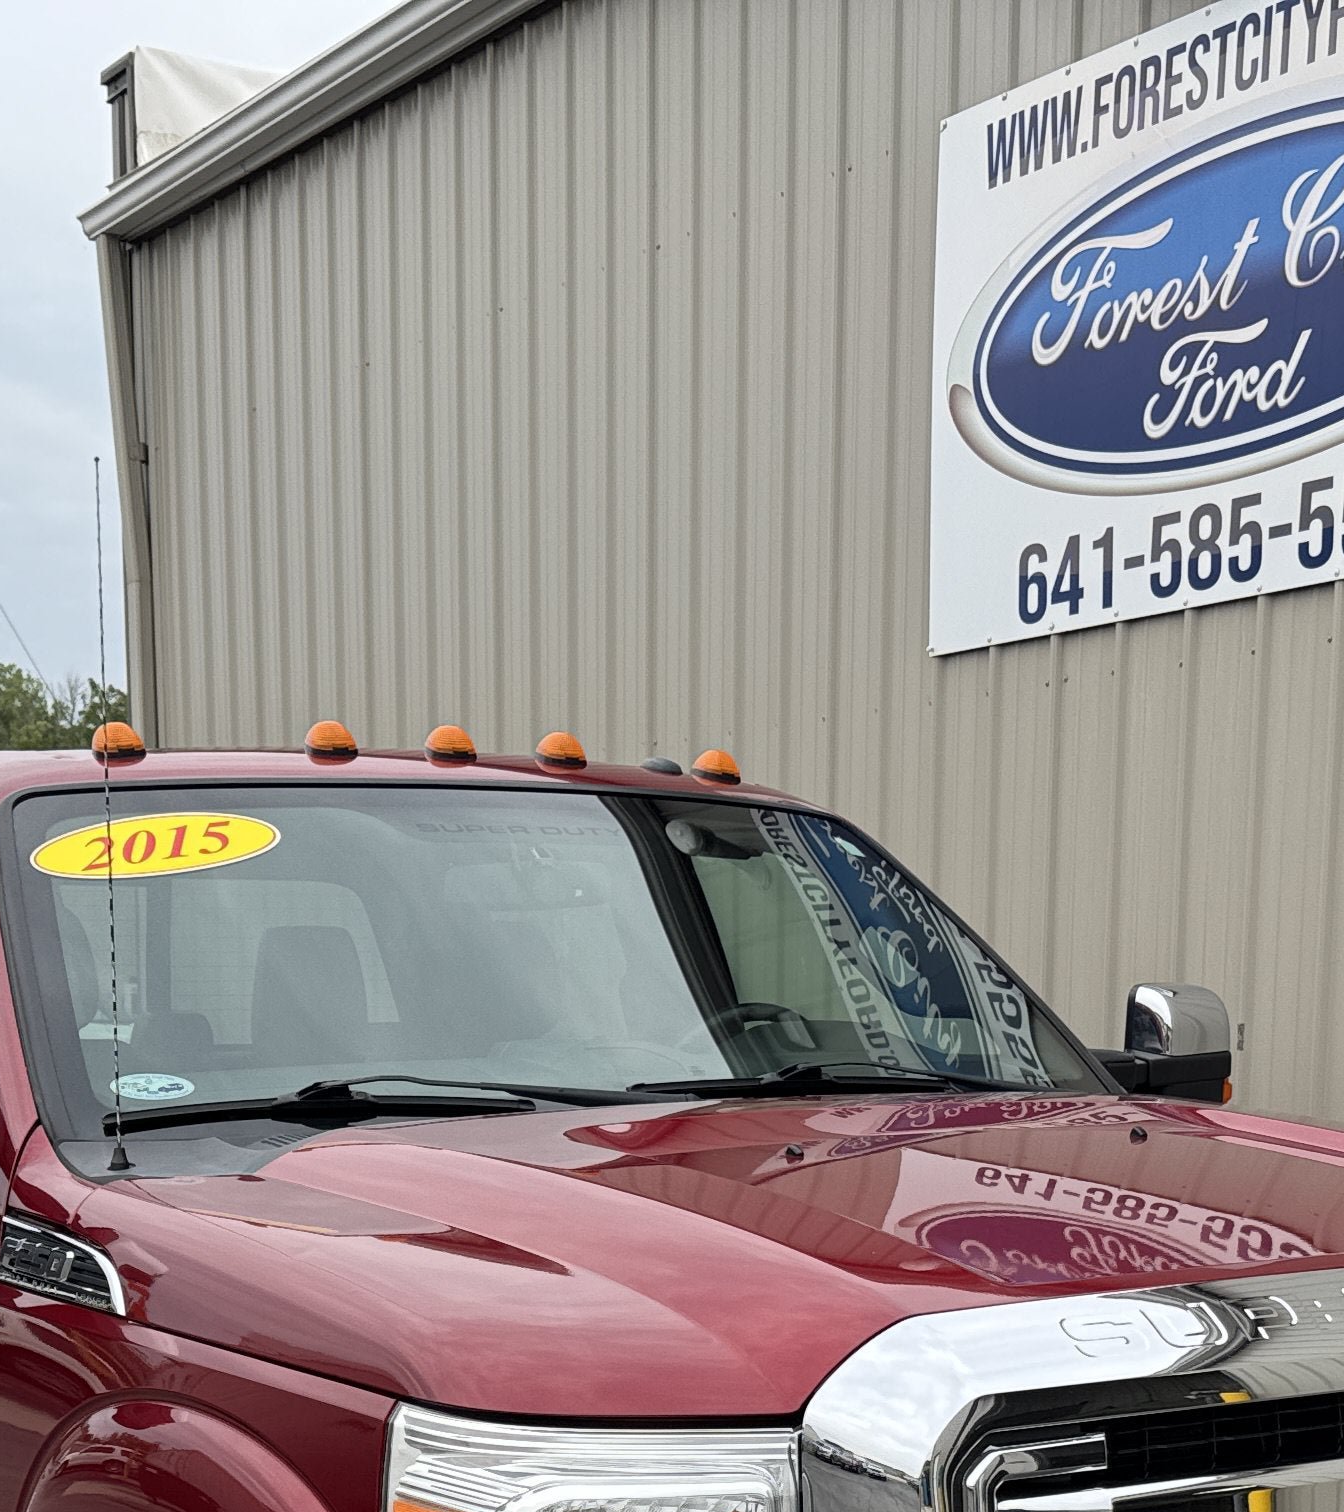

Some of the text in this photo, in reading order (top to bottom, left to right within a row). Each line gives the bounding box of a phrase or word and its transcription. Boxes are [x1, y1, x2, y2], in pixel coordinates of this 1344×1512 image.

[1031, 216, 1261, 366] Forest
[1143, 317, 1313, 439] Ford
[81, 820, 231, 872] 2015
